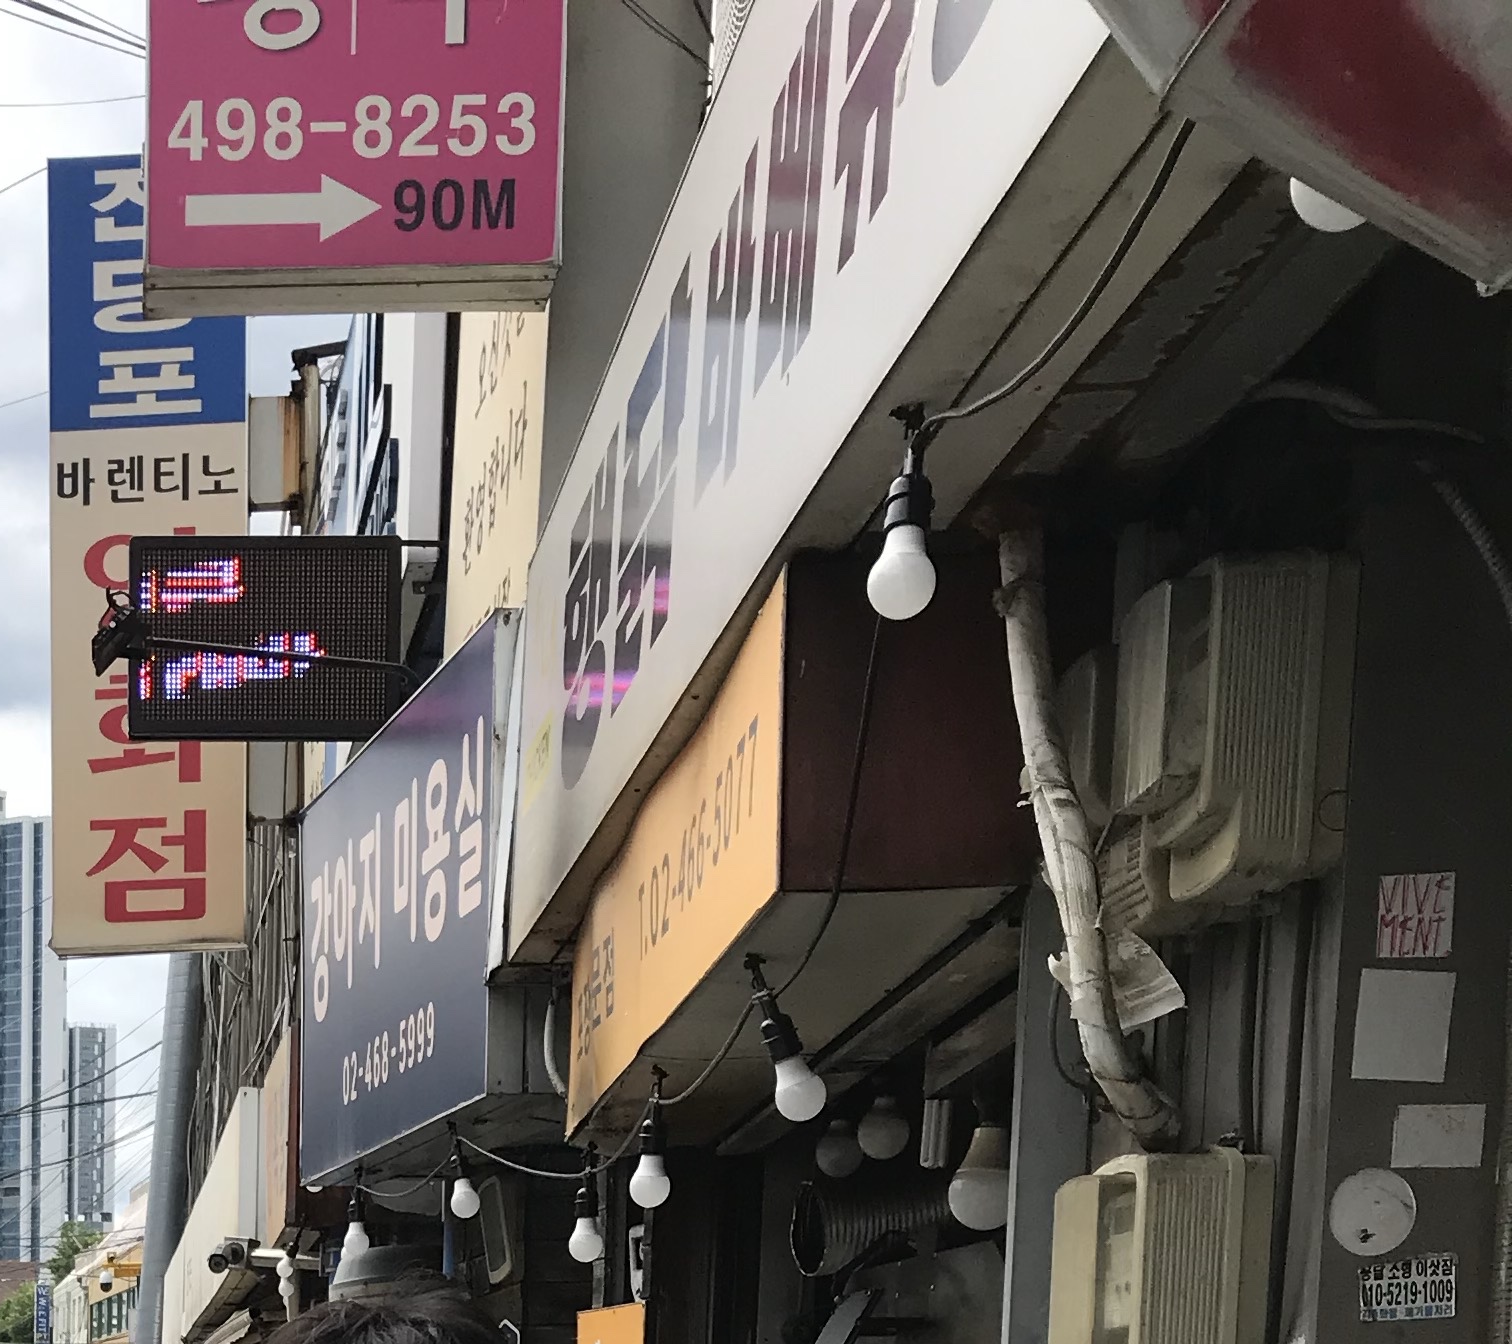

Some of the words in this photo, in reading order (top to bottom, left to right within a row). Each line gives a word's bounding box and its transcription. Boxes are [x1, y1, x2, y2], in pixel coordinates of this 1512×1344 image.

[167, 91, 537, 162] 498-8253
[392, 177, 517, 232] 90M
[56, 452, 240, 506] 바렌티노
[310, 811, 382, 1024] 강아지
[393, 714, 485, 943] 미용실
[342, 1001, 435, 1107] 02-468-5999
